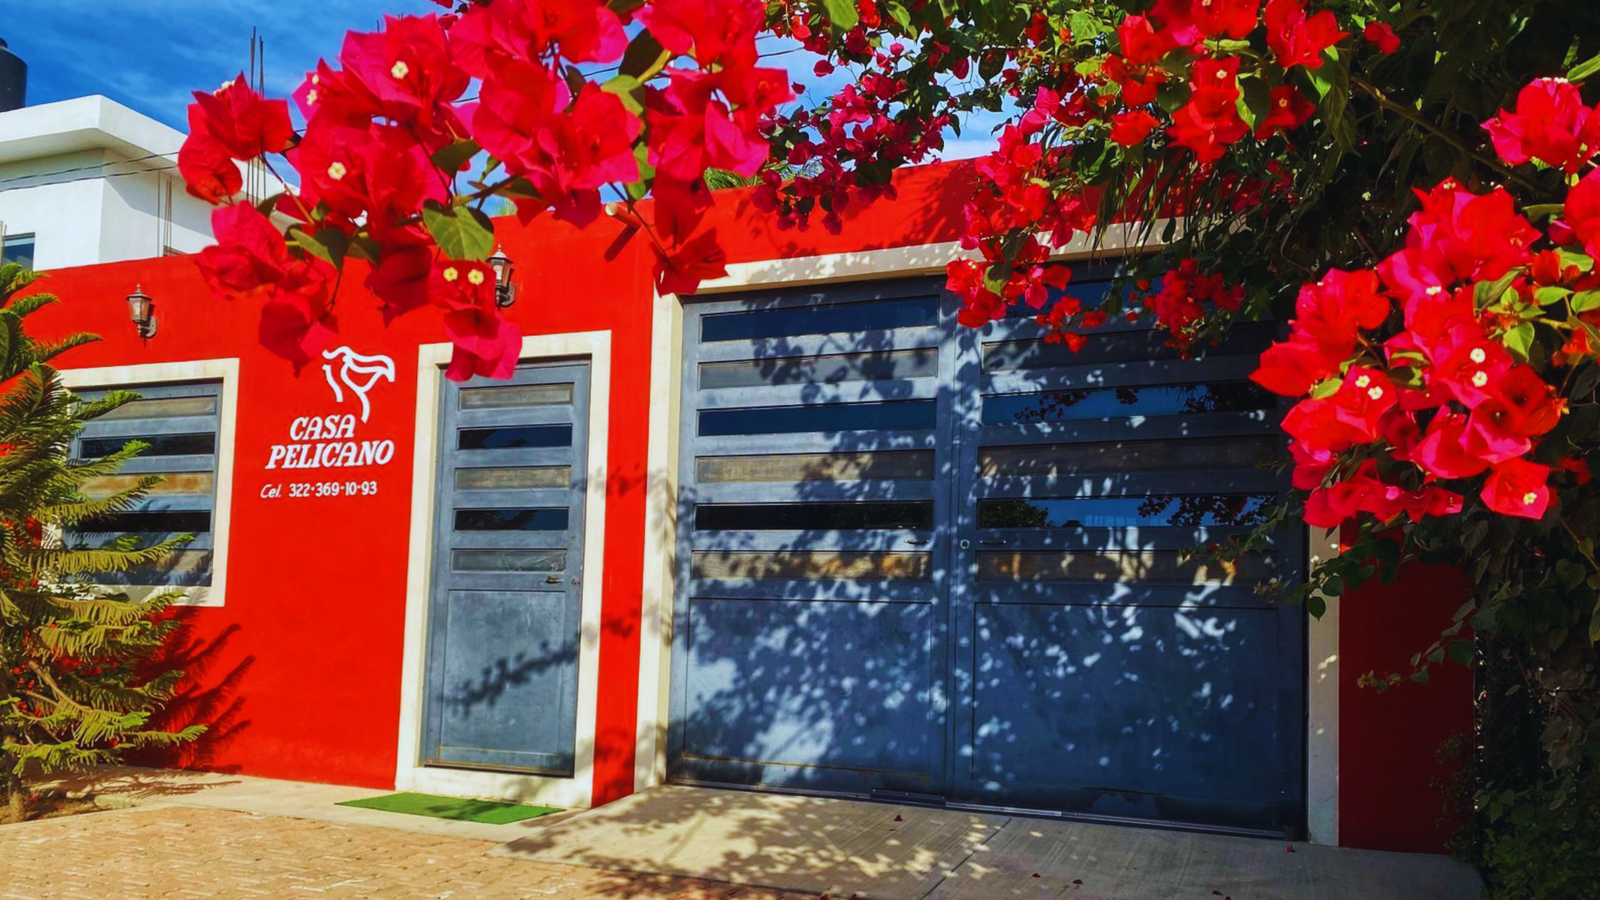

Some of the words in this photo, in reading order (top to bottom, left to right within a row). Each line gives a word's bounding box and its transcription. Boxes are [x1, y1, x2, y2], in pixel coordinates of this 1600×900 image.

[289, 413, 356, 441] CASA
[264, 439, 395, 470] PELICANO
[260, 483, 282, 499] Cel.
